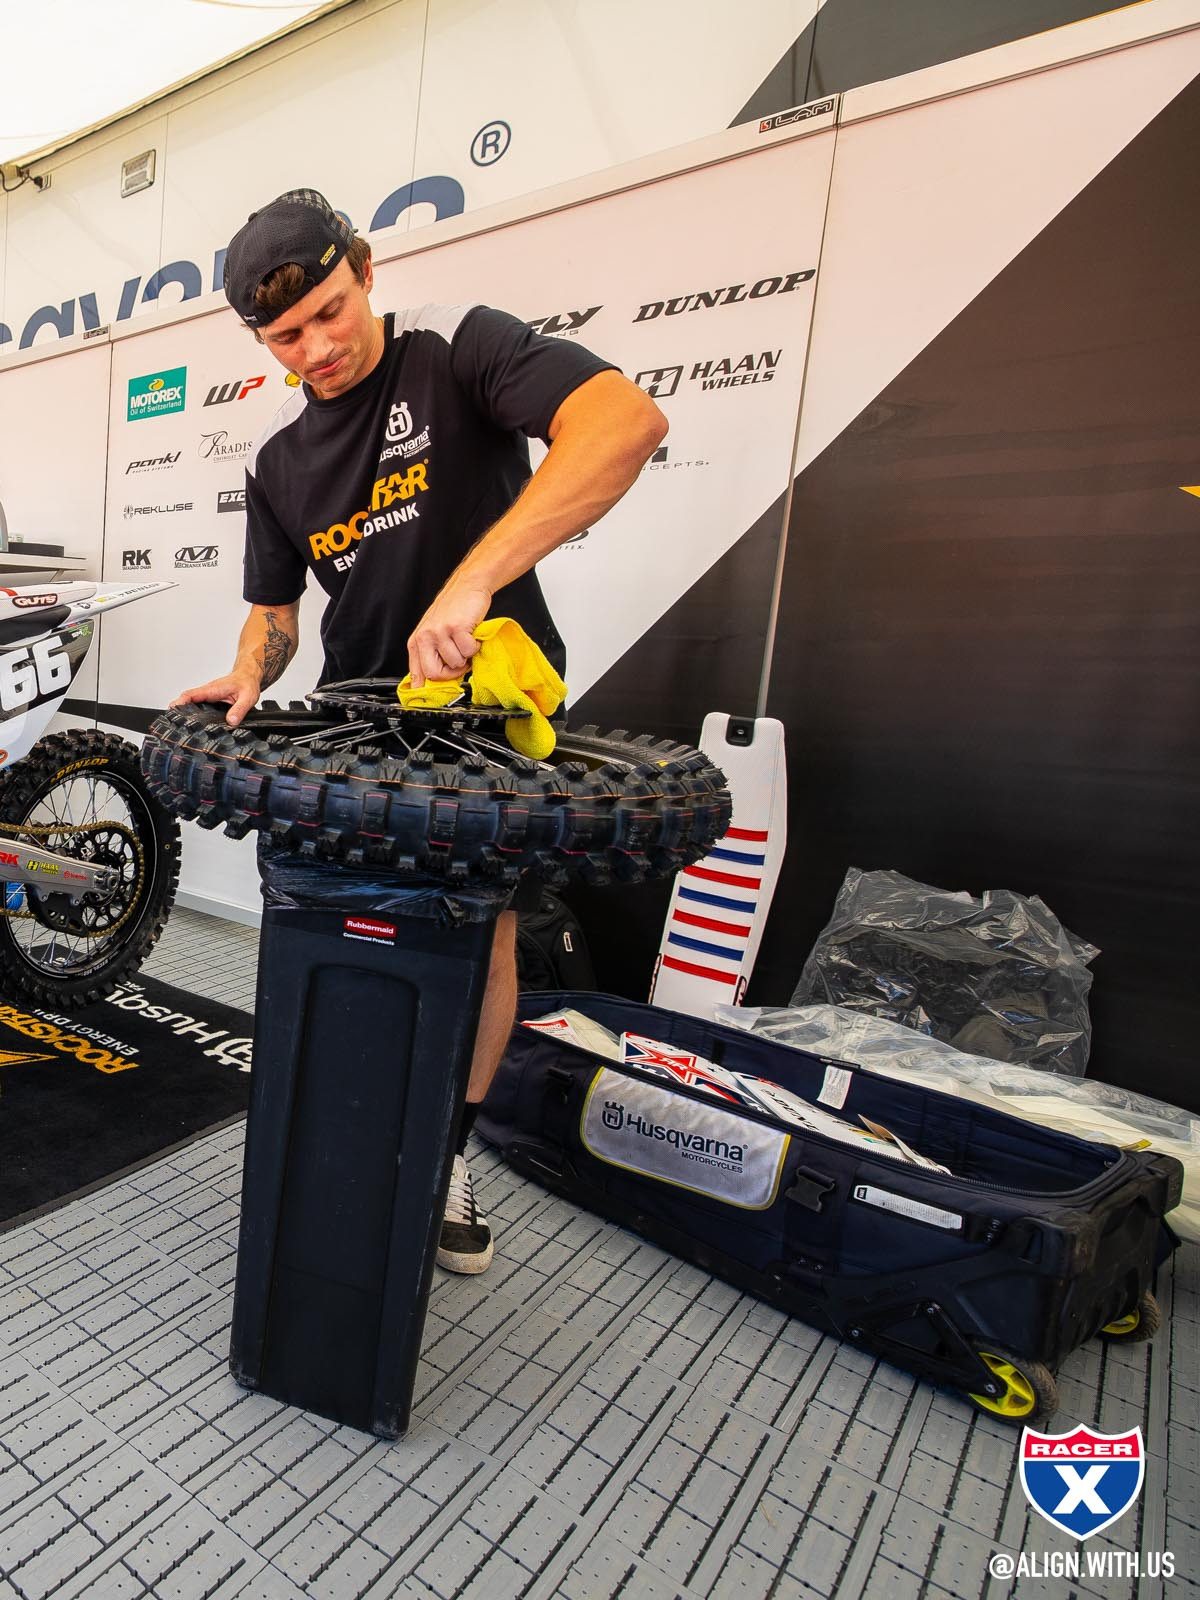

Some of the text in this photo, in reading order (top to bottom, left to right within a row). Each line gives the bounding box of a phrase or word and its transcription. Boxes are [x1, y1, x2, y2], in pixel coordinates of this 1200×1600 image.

[632, 268, 817, 324] DUNLOP
[690, 350, 783, 380] HAAN
[702, 370, 776, 391] WHEELS
[130, 400, 182, 416] Oil of Switzerland
[131, 386, 183, 409] MOTOREX
[199, 430, 253, 459] PARADIS
[379, 430, 429, 463] usqvarna
[643, 460, 705, 471] CEPTS
[218, 491, 246, 503] EXC
[134, 502, 194, 515] REKLUSE
[363, 502, 420, 538] DRINK
[122, 549, 152, 566] RK
[15, 594, 58, 607] GUTS
[56, 758, 109, 779] DUNLOP
[347, 920, 394, 935] Rubbermaid
[343, 932, 395, 946] Commercial Products
[104, 989, 230, 1044] Husqv
[68, 1022, 140, 1056] ENERGY
[626, 1113, 744, 1163] Husqvarna
[682, 1151, 744, 1175] MOTORCYCLES
